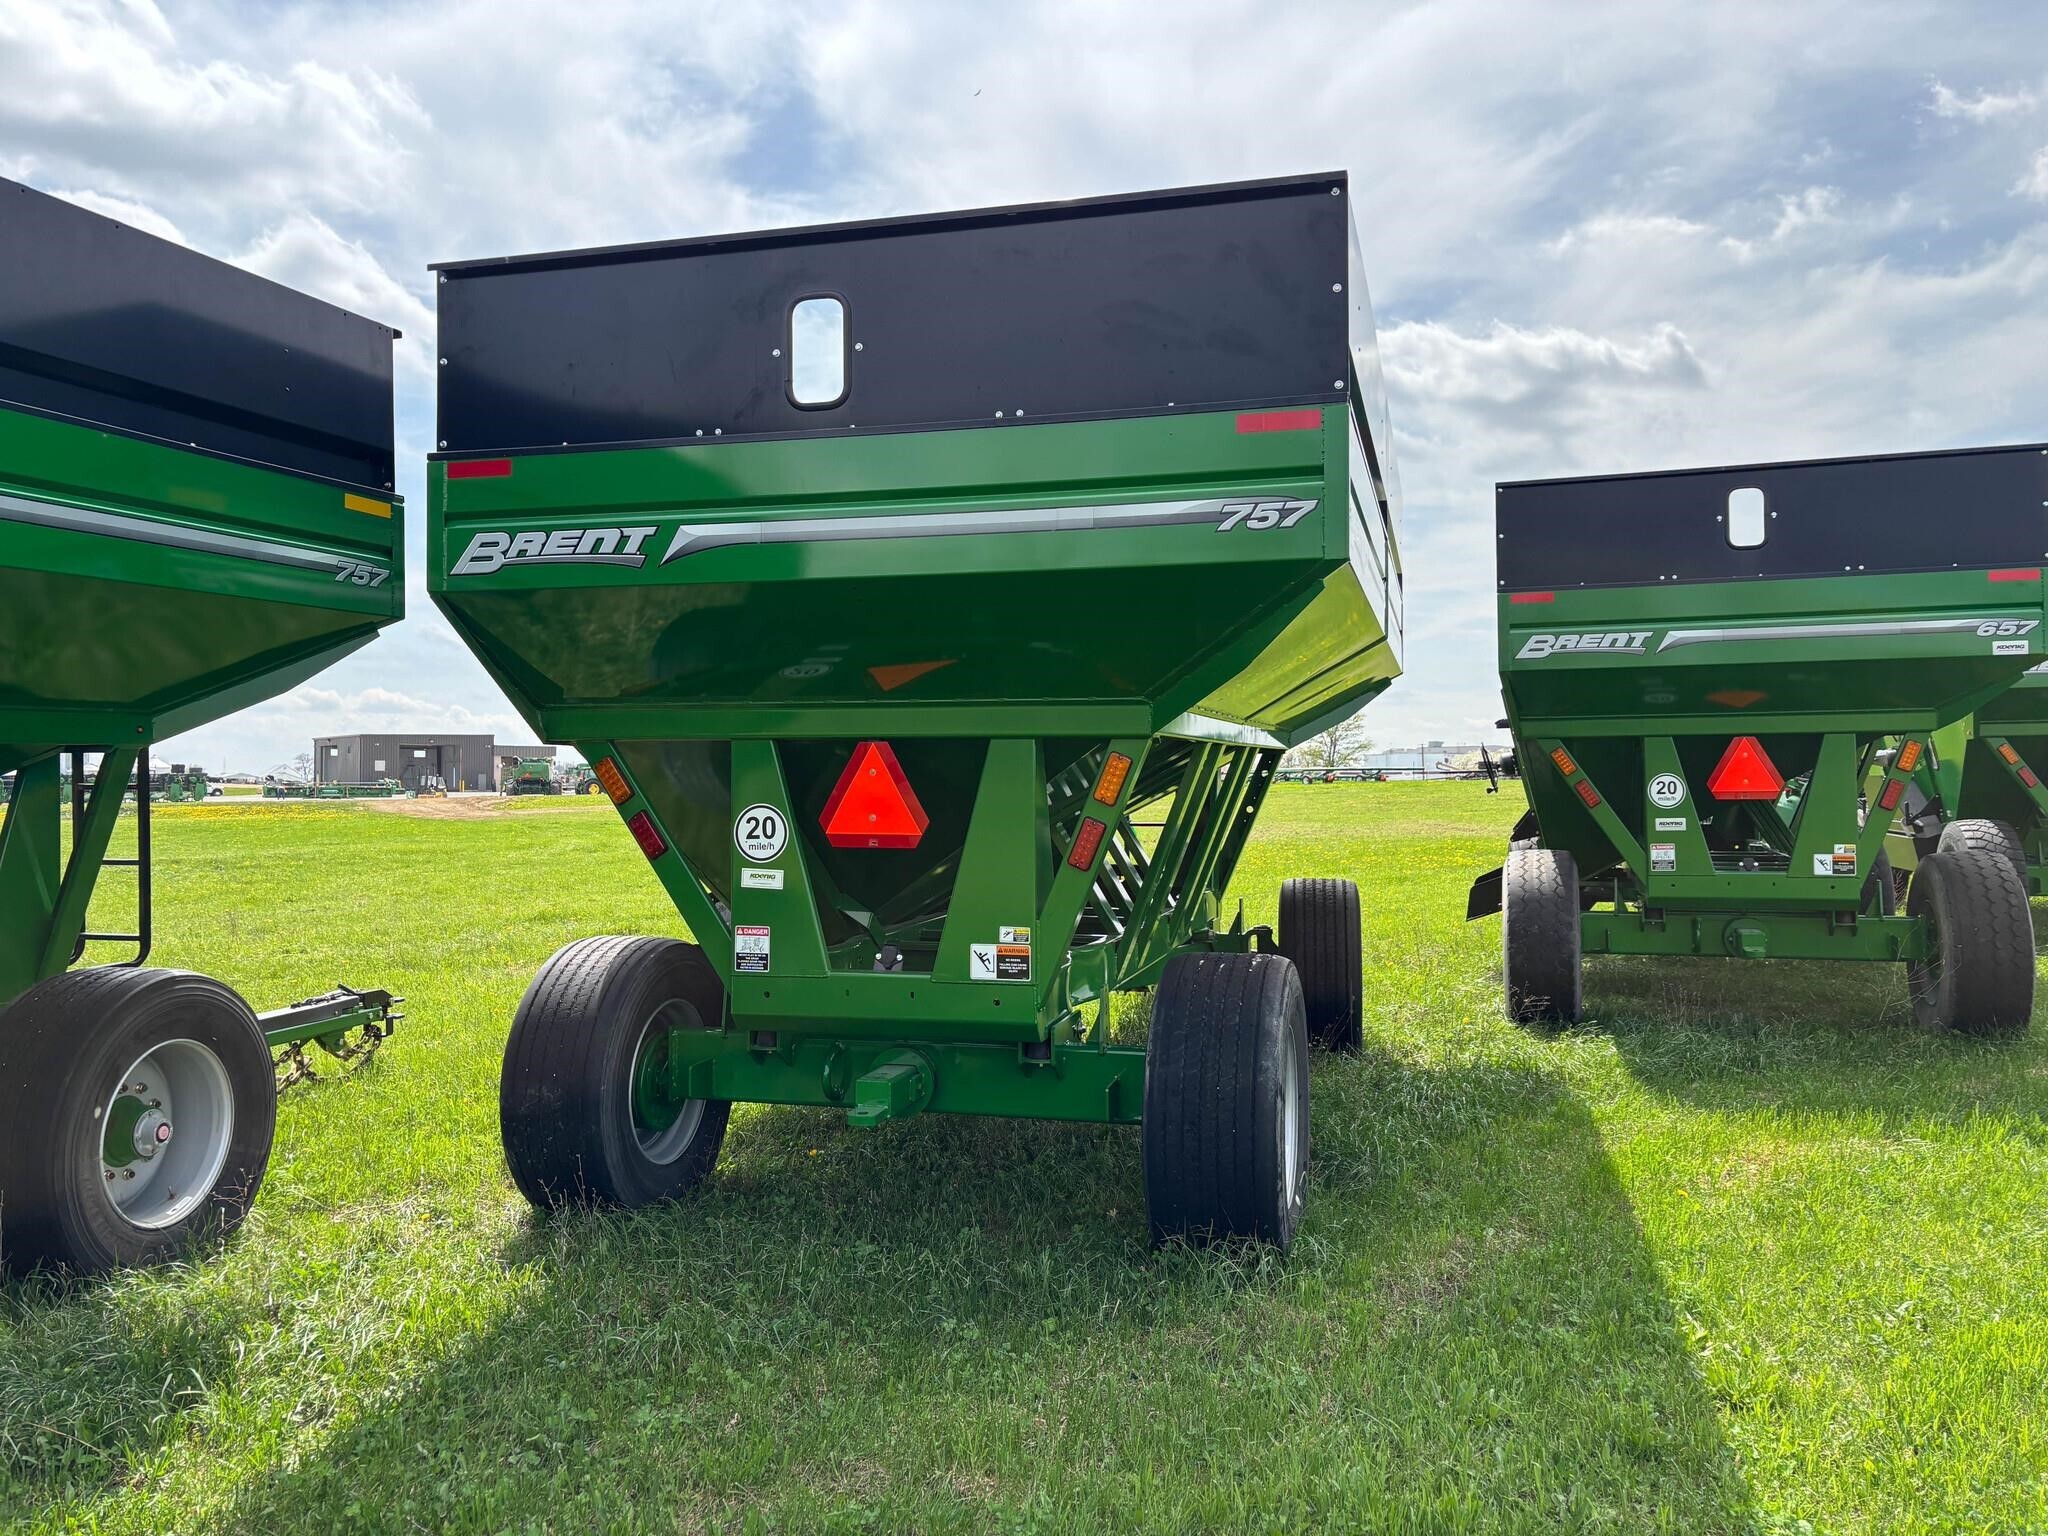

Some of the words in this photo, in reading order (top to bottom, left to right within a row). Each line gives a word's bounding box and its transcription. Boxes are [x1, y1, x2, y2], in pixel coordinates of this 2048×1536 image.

[1216, 499, 1320, 532] 757
[449, 526, 661, 576] BRENT
[335, 561, 391, 587] 757
[1976, 620, 2040, 636] 657
[1514, 631, 1654, 659] BRENT
[1656, 781, 1677, 795] 20
[745, 816, 776, 840] 20
[748, 842, 775, 851] mile/h
